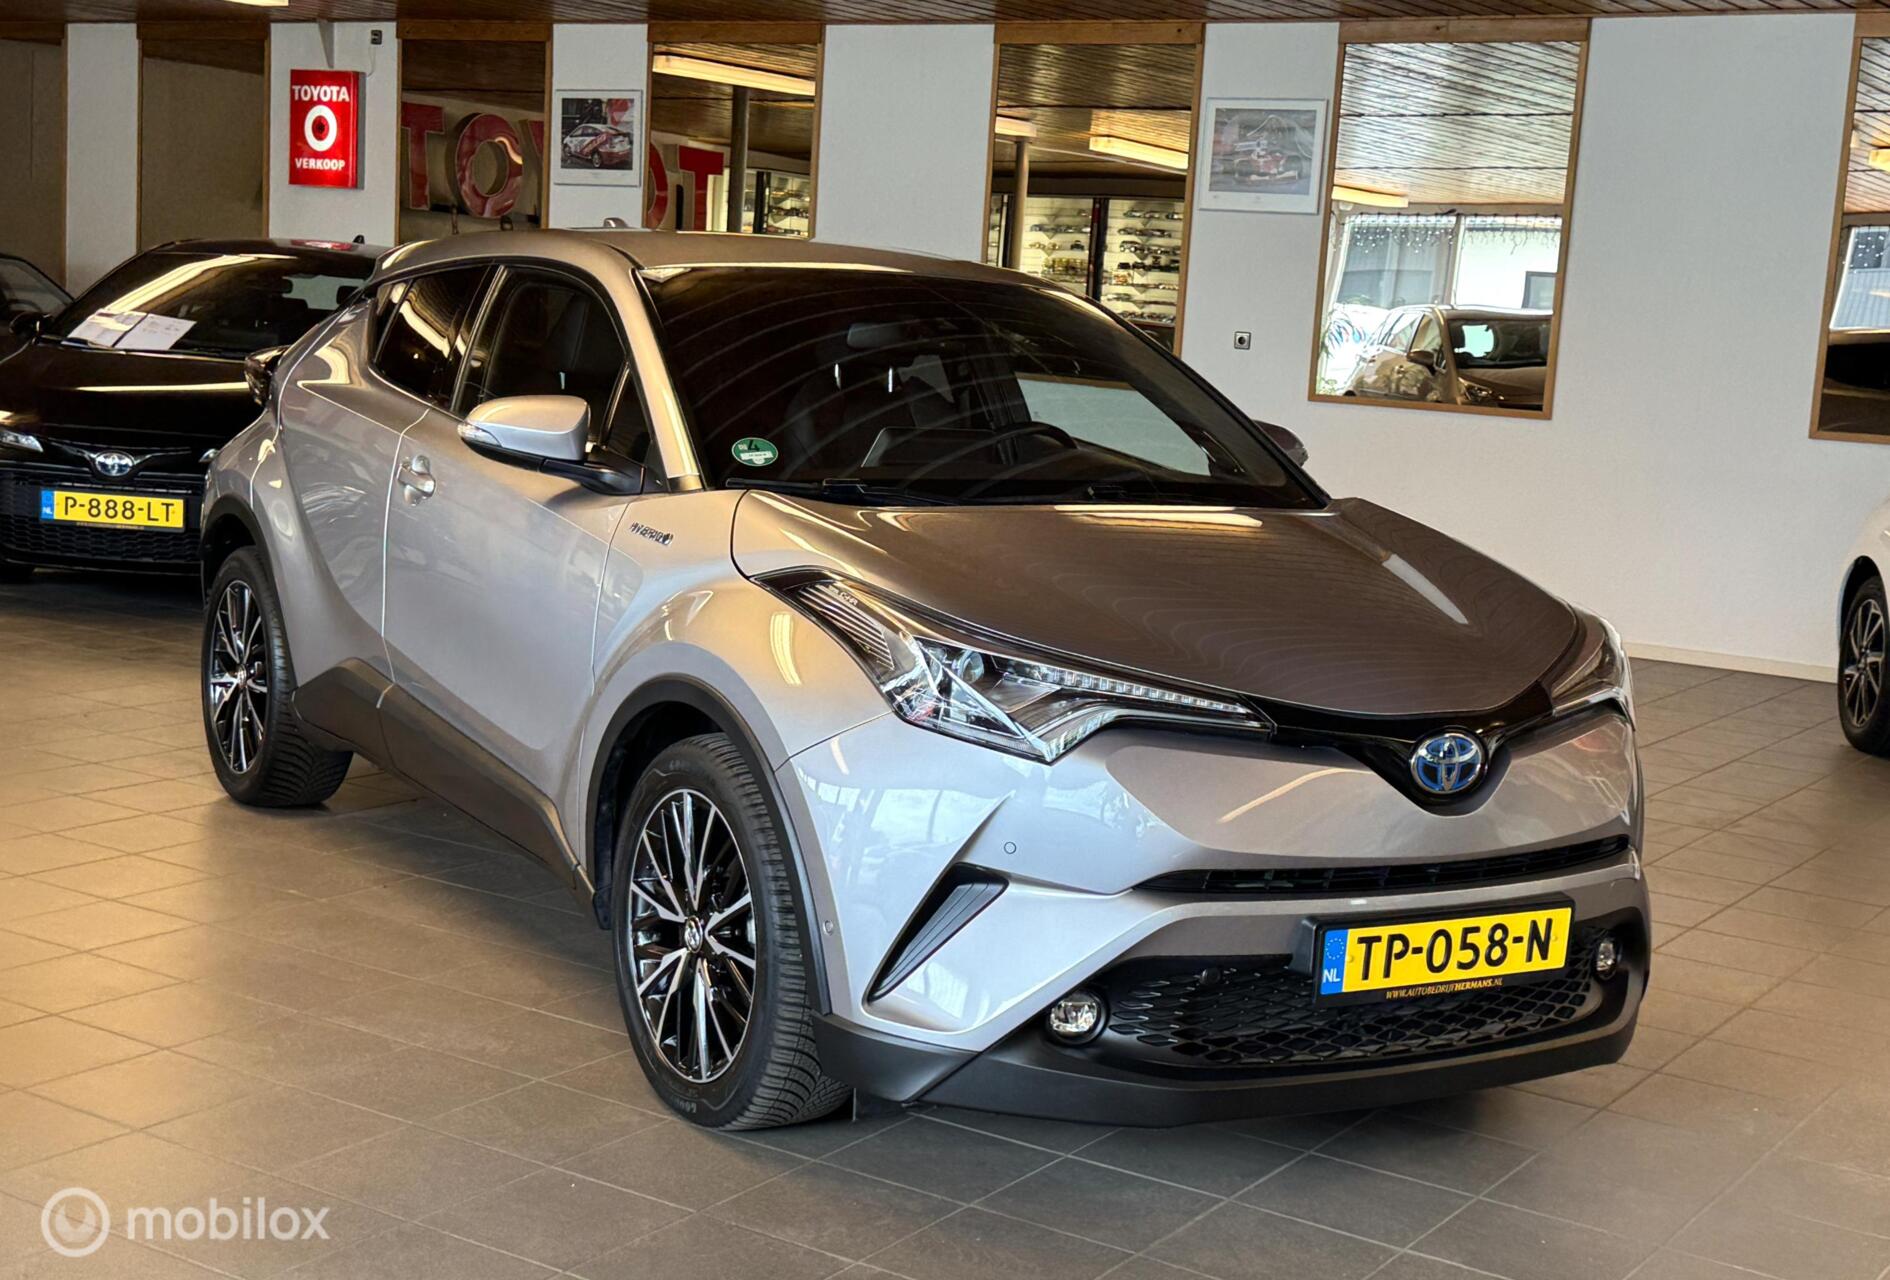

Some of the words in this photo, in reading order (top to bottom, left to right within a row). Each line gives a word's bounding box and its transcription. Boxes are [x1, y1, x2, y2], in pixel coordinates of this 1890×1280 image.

[292, 85, 350, 102] TOYOTA
[294, 158, 346, 171] VERKOOP
[64, 496, 175, 522] P-888-LT
[1357, 917, 1554, 981] TP-058-N
[1323, 968, 1341, 984] NL
